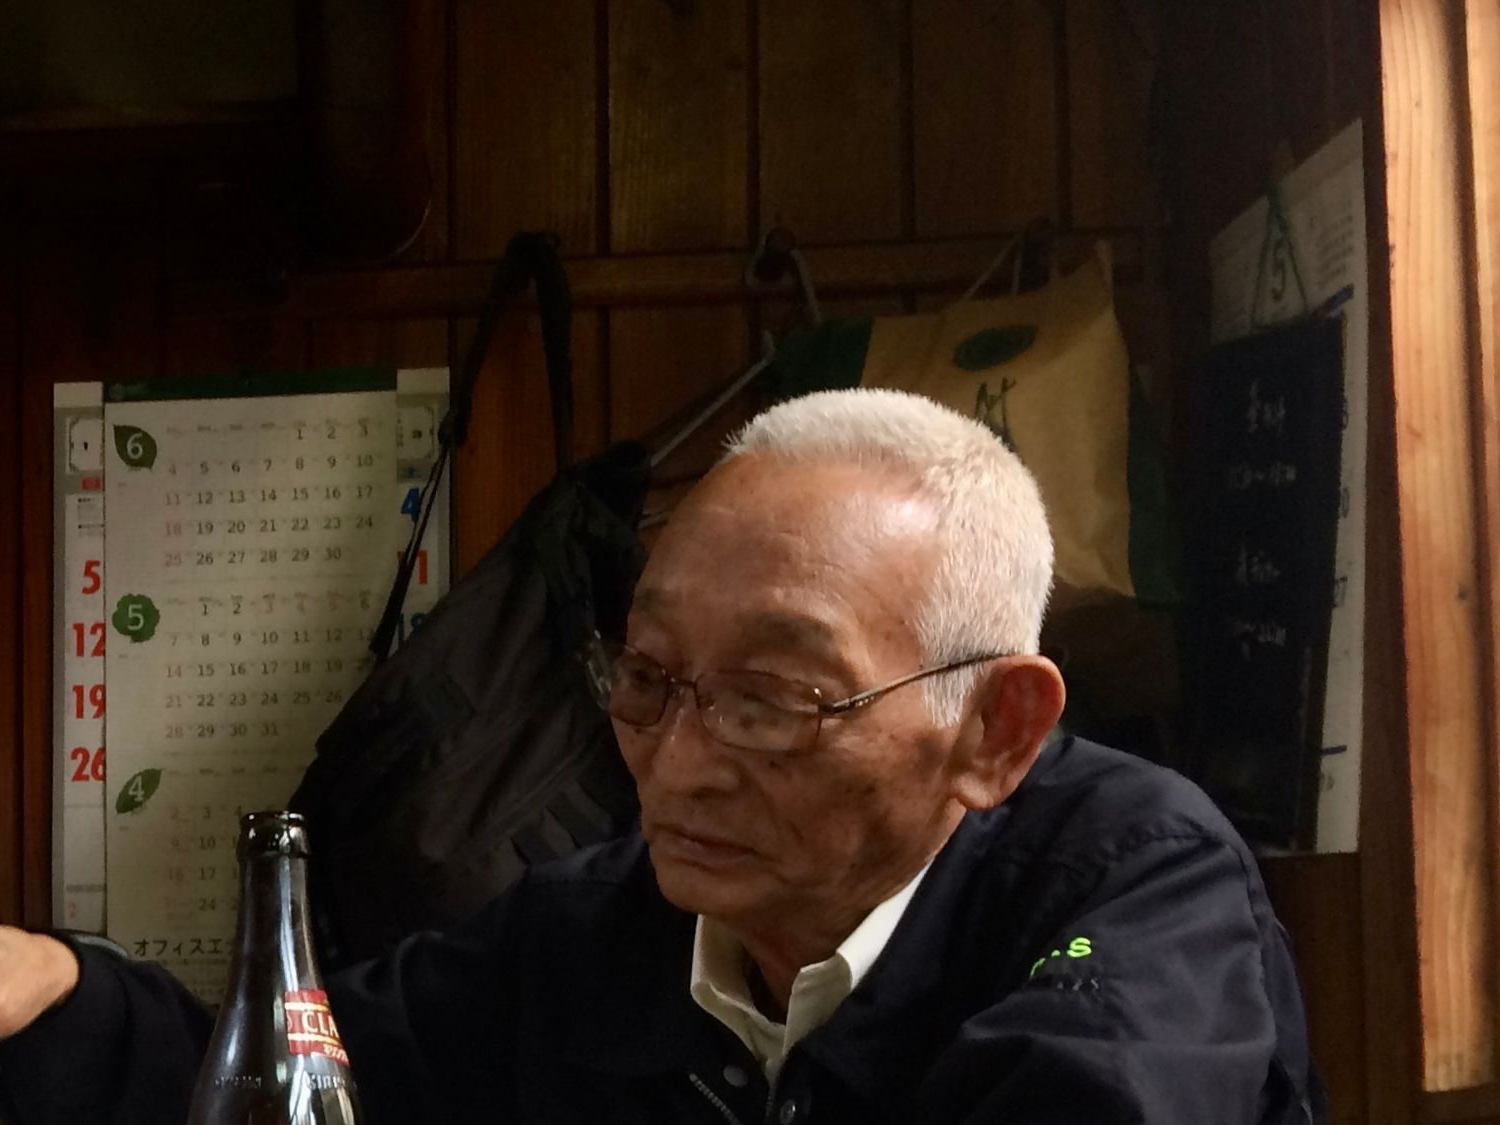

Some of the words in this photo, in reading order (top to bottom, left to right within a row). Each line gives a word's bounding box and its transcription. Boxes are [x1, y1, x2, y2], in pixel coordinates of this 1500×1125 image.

[327, 426, 336, 439] 2
[127, 432, 143, 459] 6
[200, 461, 209, 474] 5
[231, 460, 240, 473] 6
[264, 458, 272, 472] 7
[327, 456, 337, 468] 9
[357, 454, 373, 468] 10
[198, 490, 213, 504] 12
[229, 490, 245, 503] 13
[261, 488, 277, 502] 14
[293, 487, 309, 500] 15
[325, 487, 341, 499] 16
[356, 485, 373, 498] 17
[198, 522, 213, 535] 19
[228, 520, 245, 533] 20
[260, 519, 276, 532] 21
[292, 518, 309, 531] 22
[324, 516, 340, 530] 23
[356, 516, 373, 528] 24
[196, 551, 213, 565] 26
[228, 551, 245, 563] 27
[260, 549, 277, 563] 28
[292, 548, 309, 561] 29
[82, 561, 102, 594] 5
[127, 604, 144, 631] 5
[203, 603, 208, 616] 1
[233, 603, 241, 614] 2
[73, 623, 107, 657] 12
[201, 633, 210, 646] 8
[233, 632, 241, 644] 9
[261, 631, 278, 645] 10
[294, 630, 309, 643] 11
[198, 664, 214, 677] 15
[230, 662, 246, 675] 16
[261, 661, 277, 675] 17
[72, 685, 107, 719] 19
[197, 694, 214, 707] 22
[229, 693, 247, 706] 23
[261, 692, 278, 705] 24
[198, 724, 214, 737] 29
[229, 723, 247, 736] 30
[261, 722, 278, 736] 31
[71, 747, 107, 782] 26
[128, 776, 145, 802] 4
